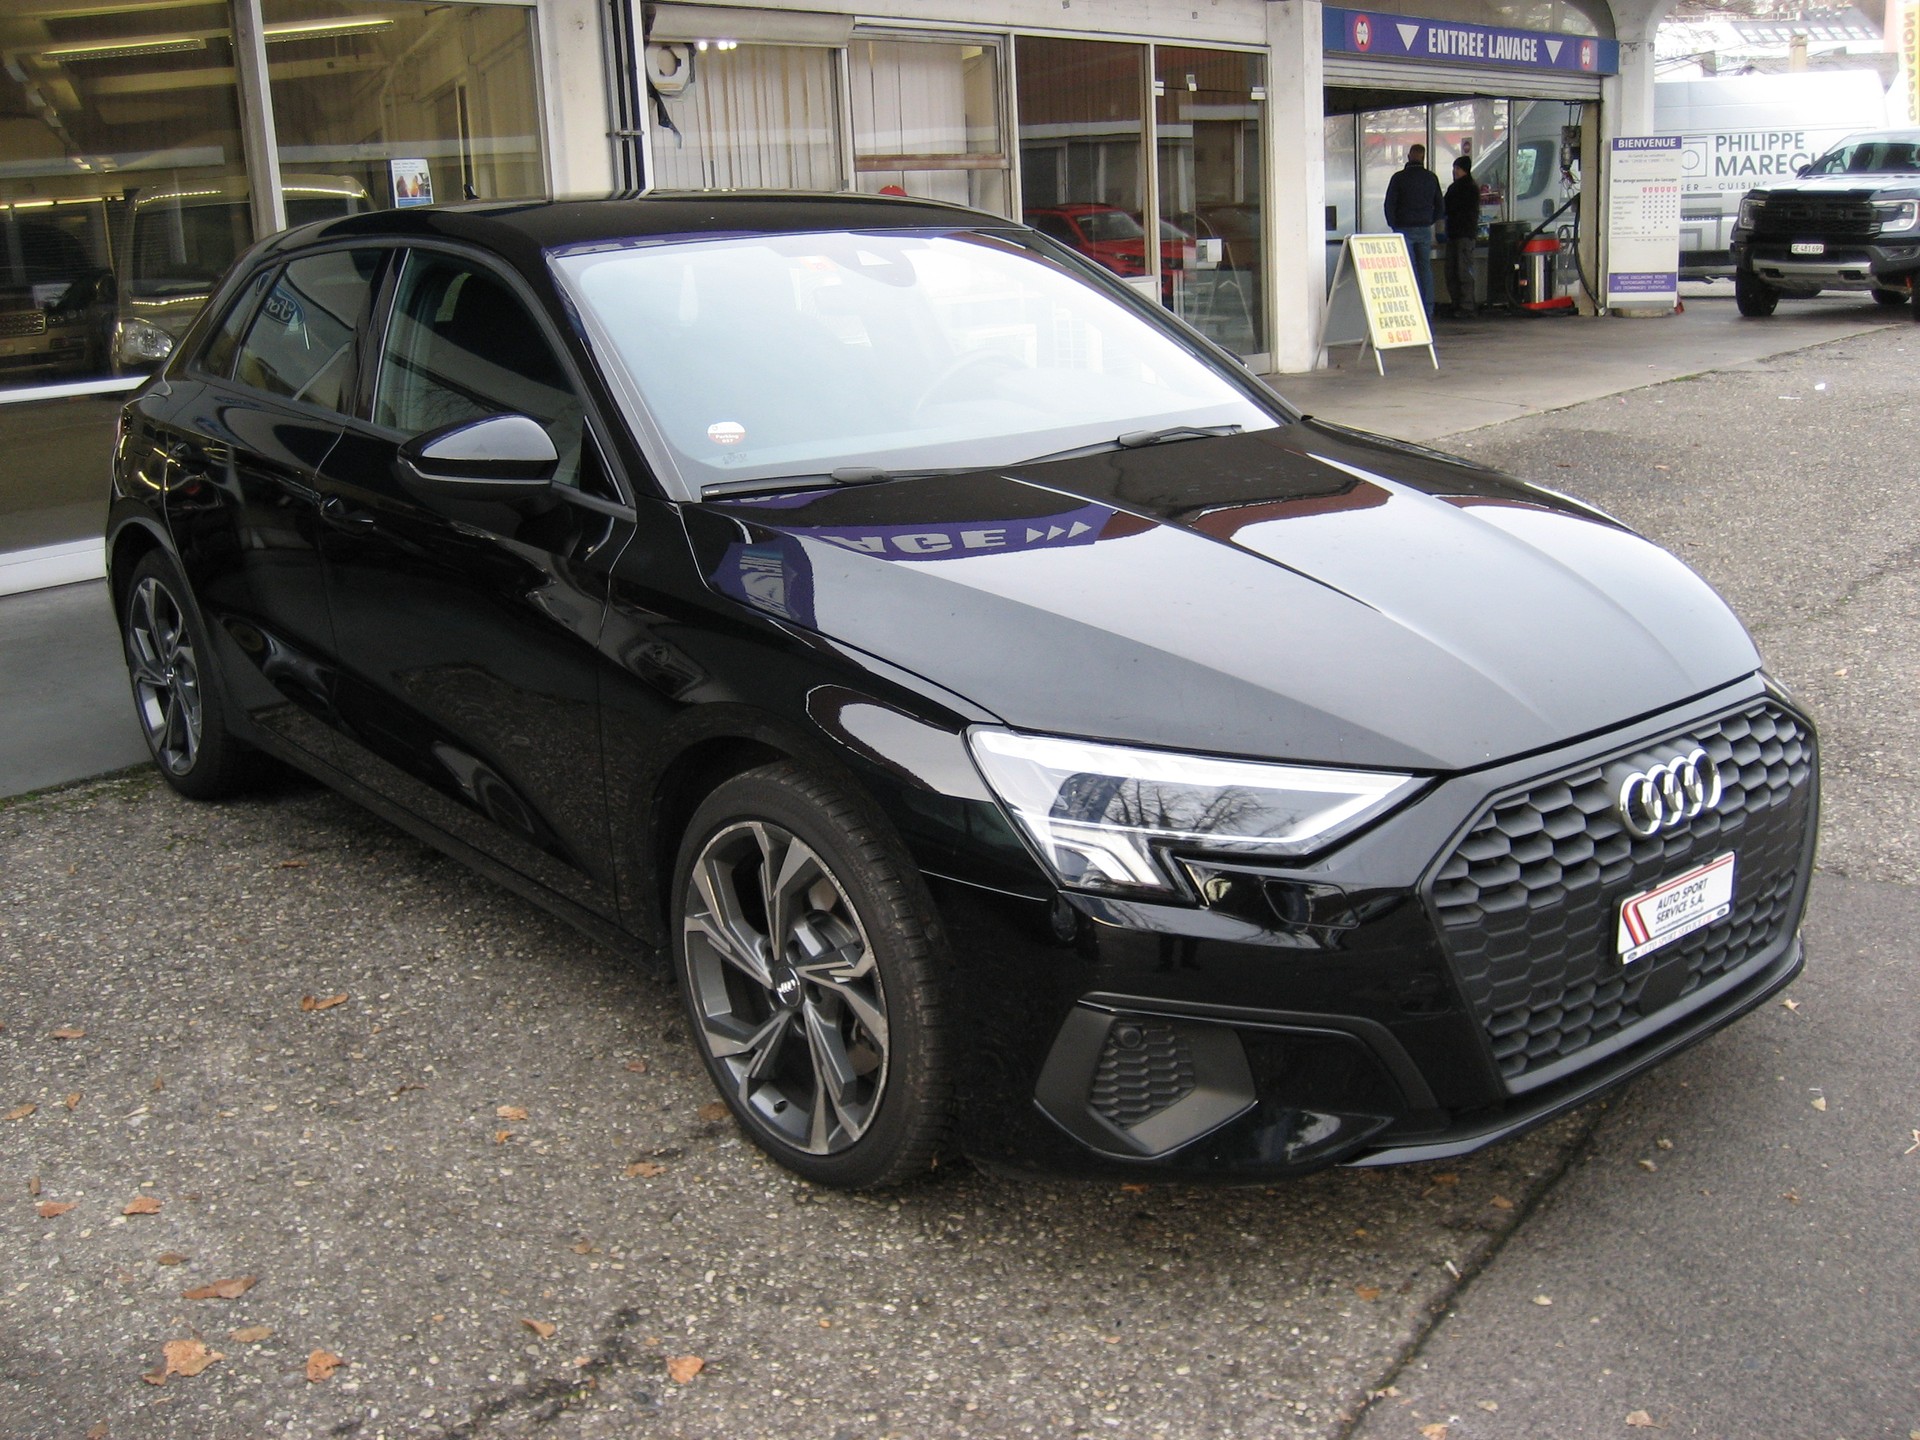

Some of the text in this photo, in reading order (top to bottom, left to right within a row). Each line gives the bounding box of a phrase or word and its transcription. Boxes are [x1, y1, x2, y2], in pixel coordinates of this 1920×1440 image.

[1428, 28, 1537, 62] ENTREE LAVAGE
[1618, 138, 1676, 148] BIENVENUE
[1715, 132, 1805, 152] PHILIPPE
[1360, 241, 1397, 254] TOUS LES
[1359, 256, 1407, 270] MERCREDIS
[1374, 271, 1399, 285] OFFRE
[1371, 285, 1410, 300] SPECIALE
[1377, 301, 1409, 314] LAVAGE
[1378, 315, 1417, 329] EXPRESS
[1388, 330, 1413, 343] 9 CHF
[1656, 878, 1708, 911] AUTO SPORT
[1656, 894, 1705, 924] SERVICE S.A.
